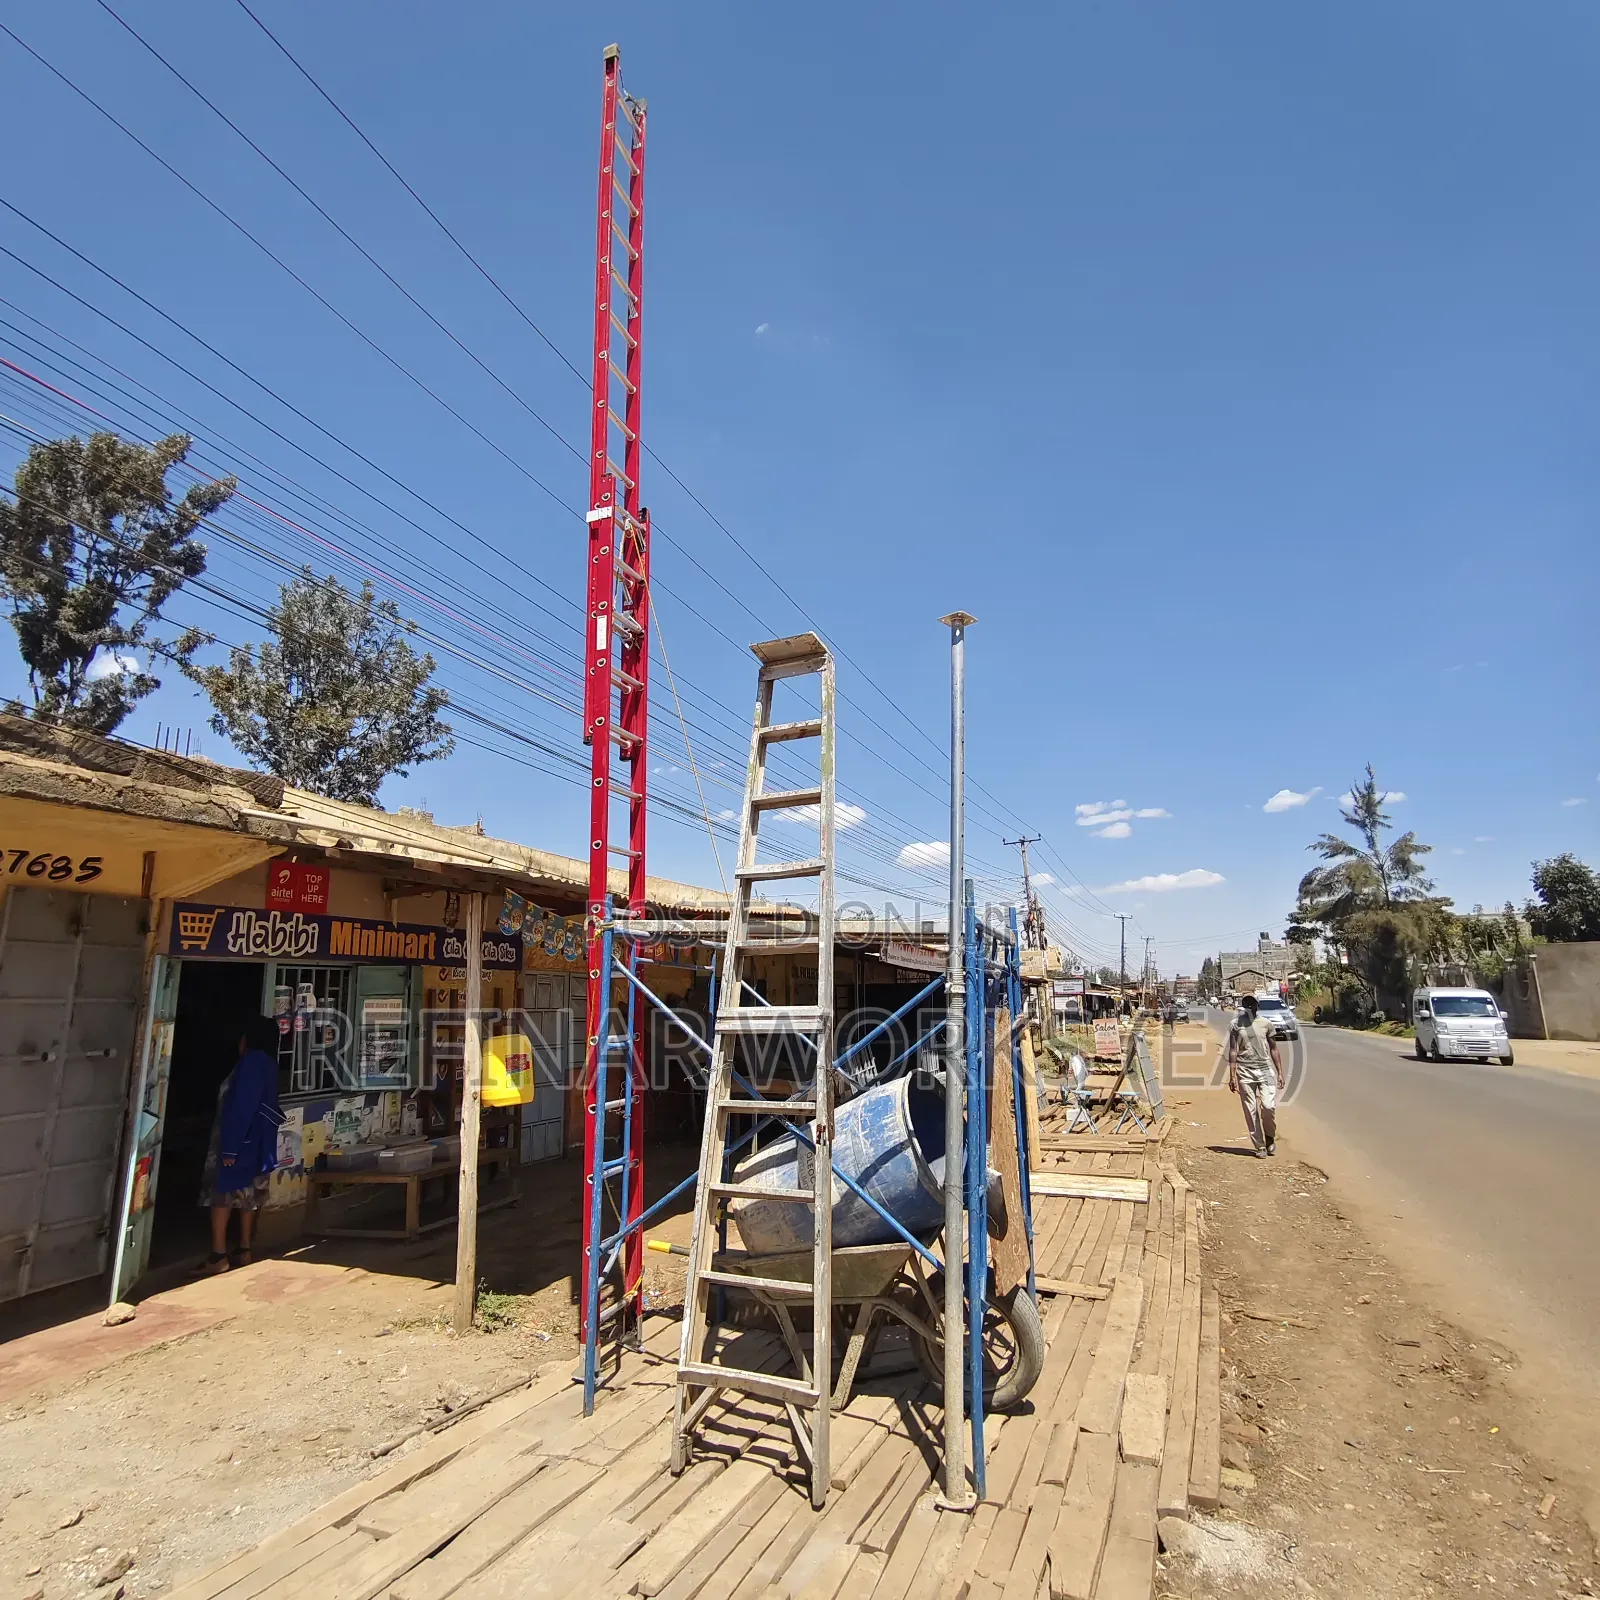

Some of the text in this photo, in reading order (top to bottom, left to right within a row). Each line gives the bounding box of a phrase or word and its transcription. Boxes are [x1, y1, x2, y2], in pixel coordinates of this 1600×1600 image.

[305, 873, 322, 883] TOP
[271, 886, 293, 898] airtel
[307, 884, 319, 893] UP
[301, 894, 324, 904] HERE
[227, 911, 319, 957] Habibi
[330, 921, 436, 960] Minimart
[443, 937, 462, 958] Kila
[482, 941, 498, 960] Kila
[499, 943, 516, 962] Siku
[1095, 1023, 1117, 1032] Salon
[806, 1151, 816, 1187] OLEOC
